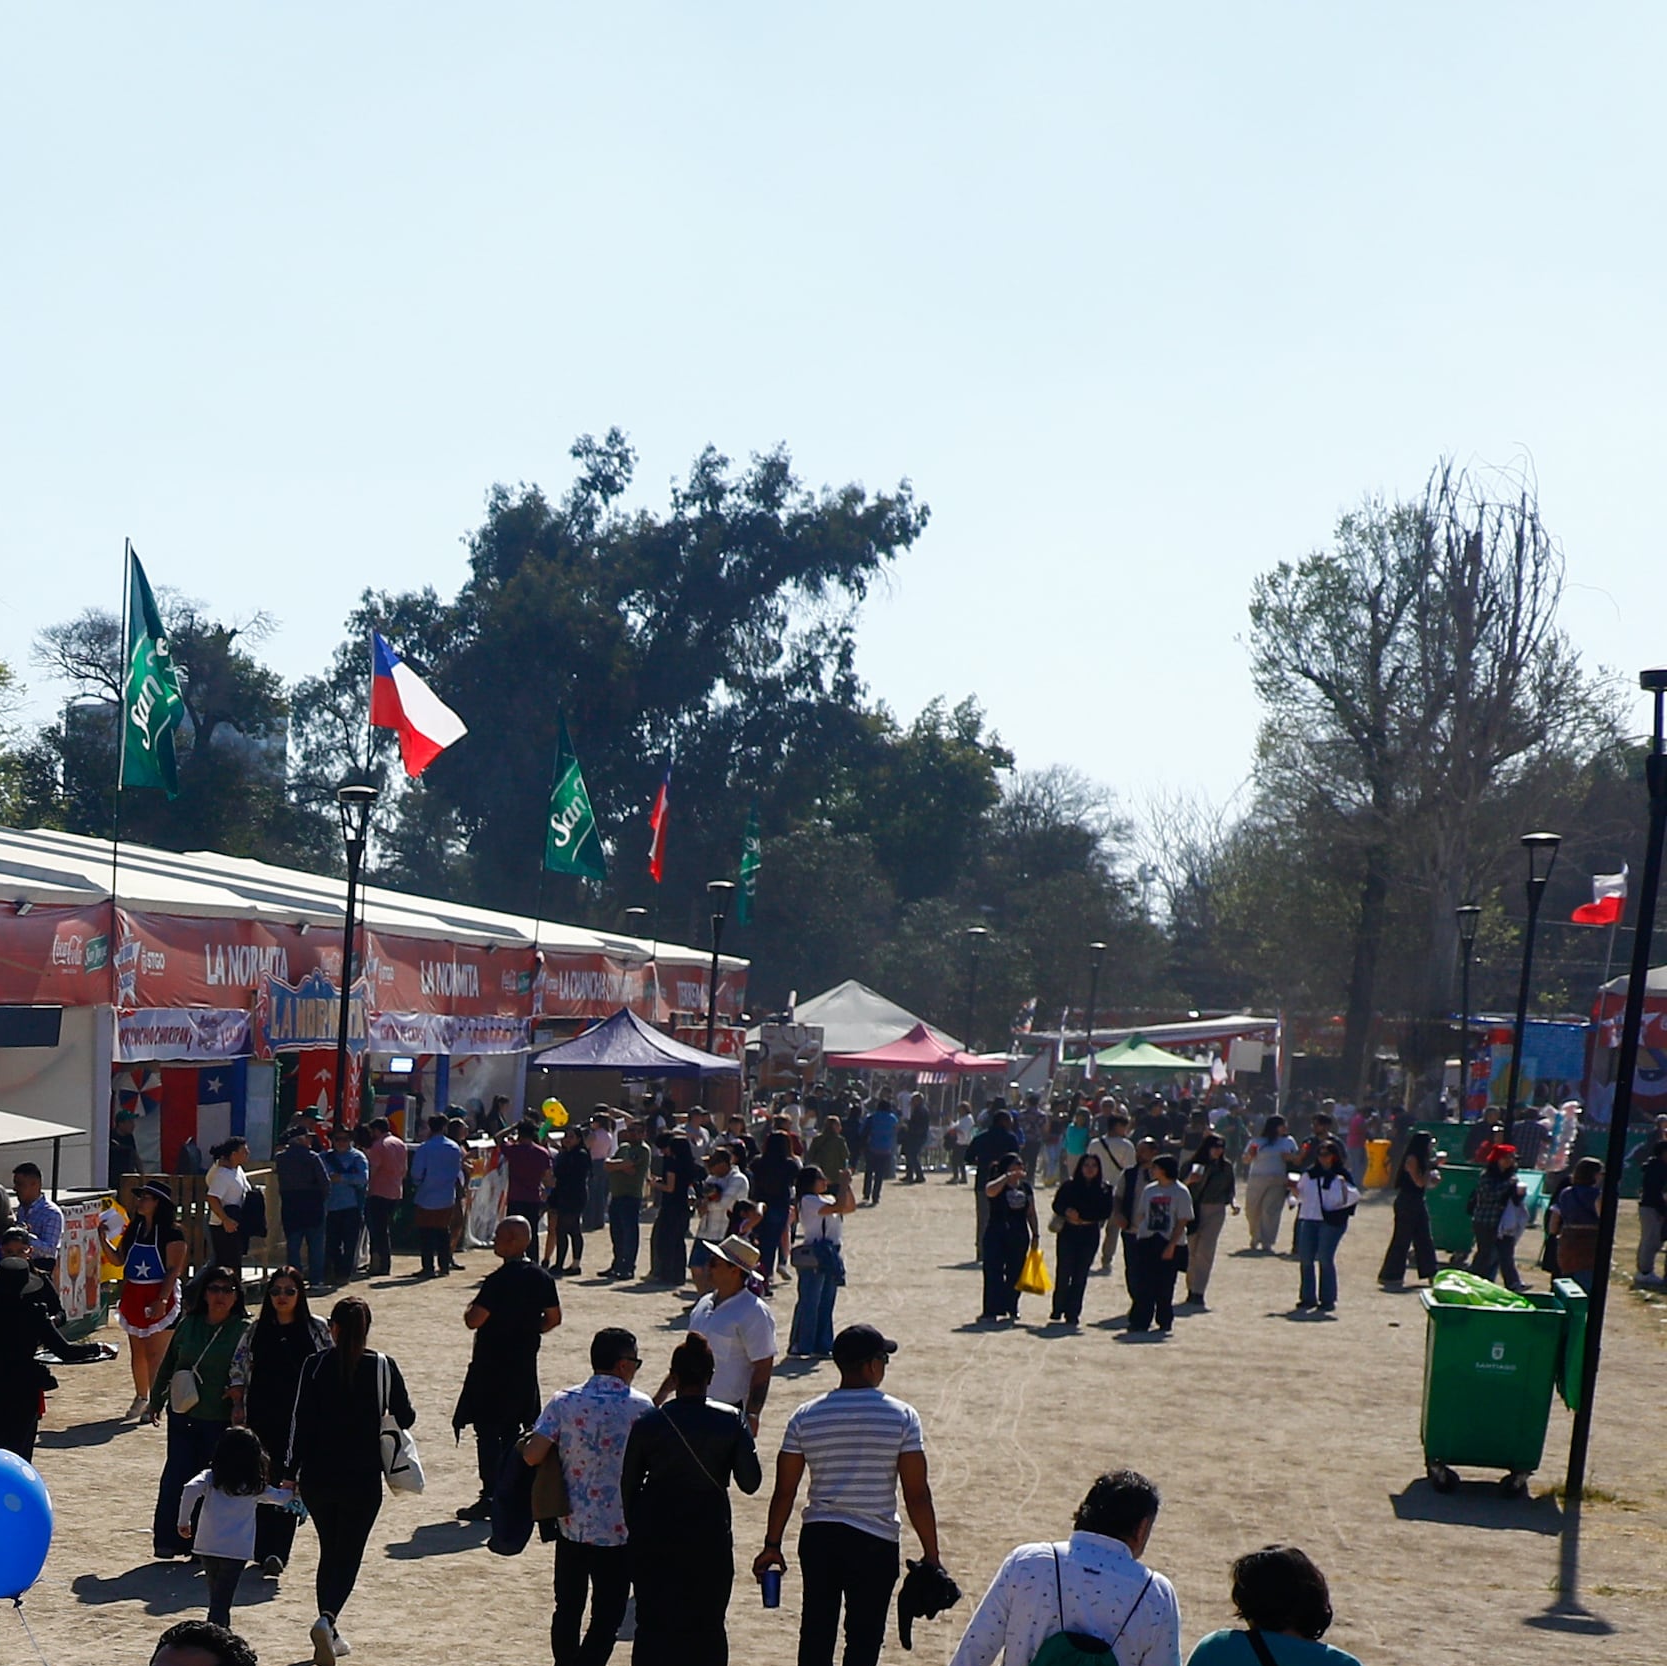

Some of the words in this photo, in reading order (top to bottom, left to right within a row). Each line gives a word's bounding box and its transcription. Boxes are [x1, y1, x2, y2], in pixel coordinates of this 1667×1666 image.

[550, 796, 588, 848] San
[205, 943, 226, 985] LA
[227, 945, 290, 987] NORMITA
[270, 996, 293, 1040] LA
